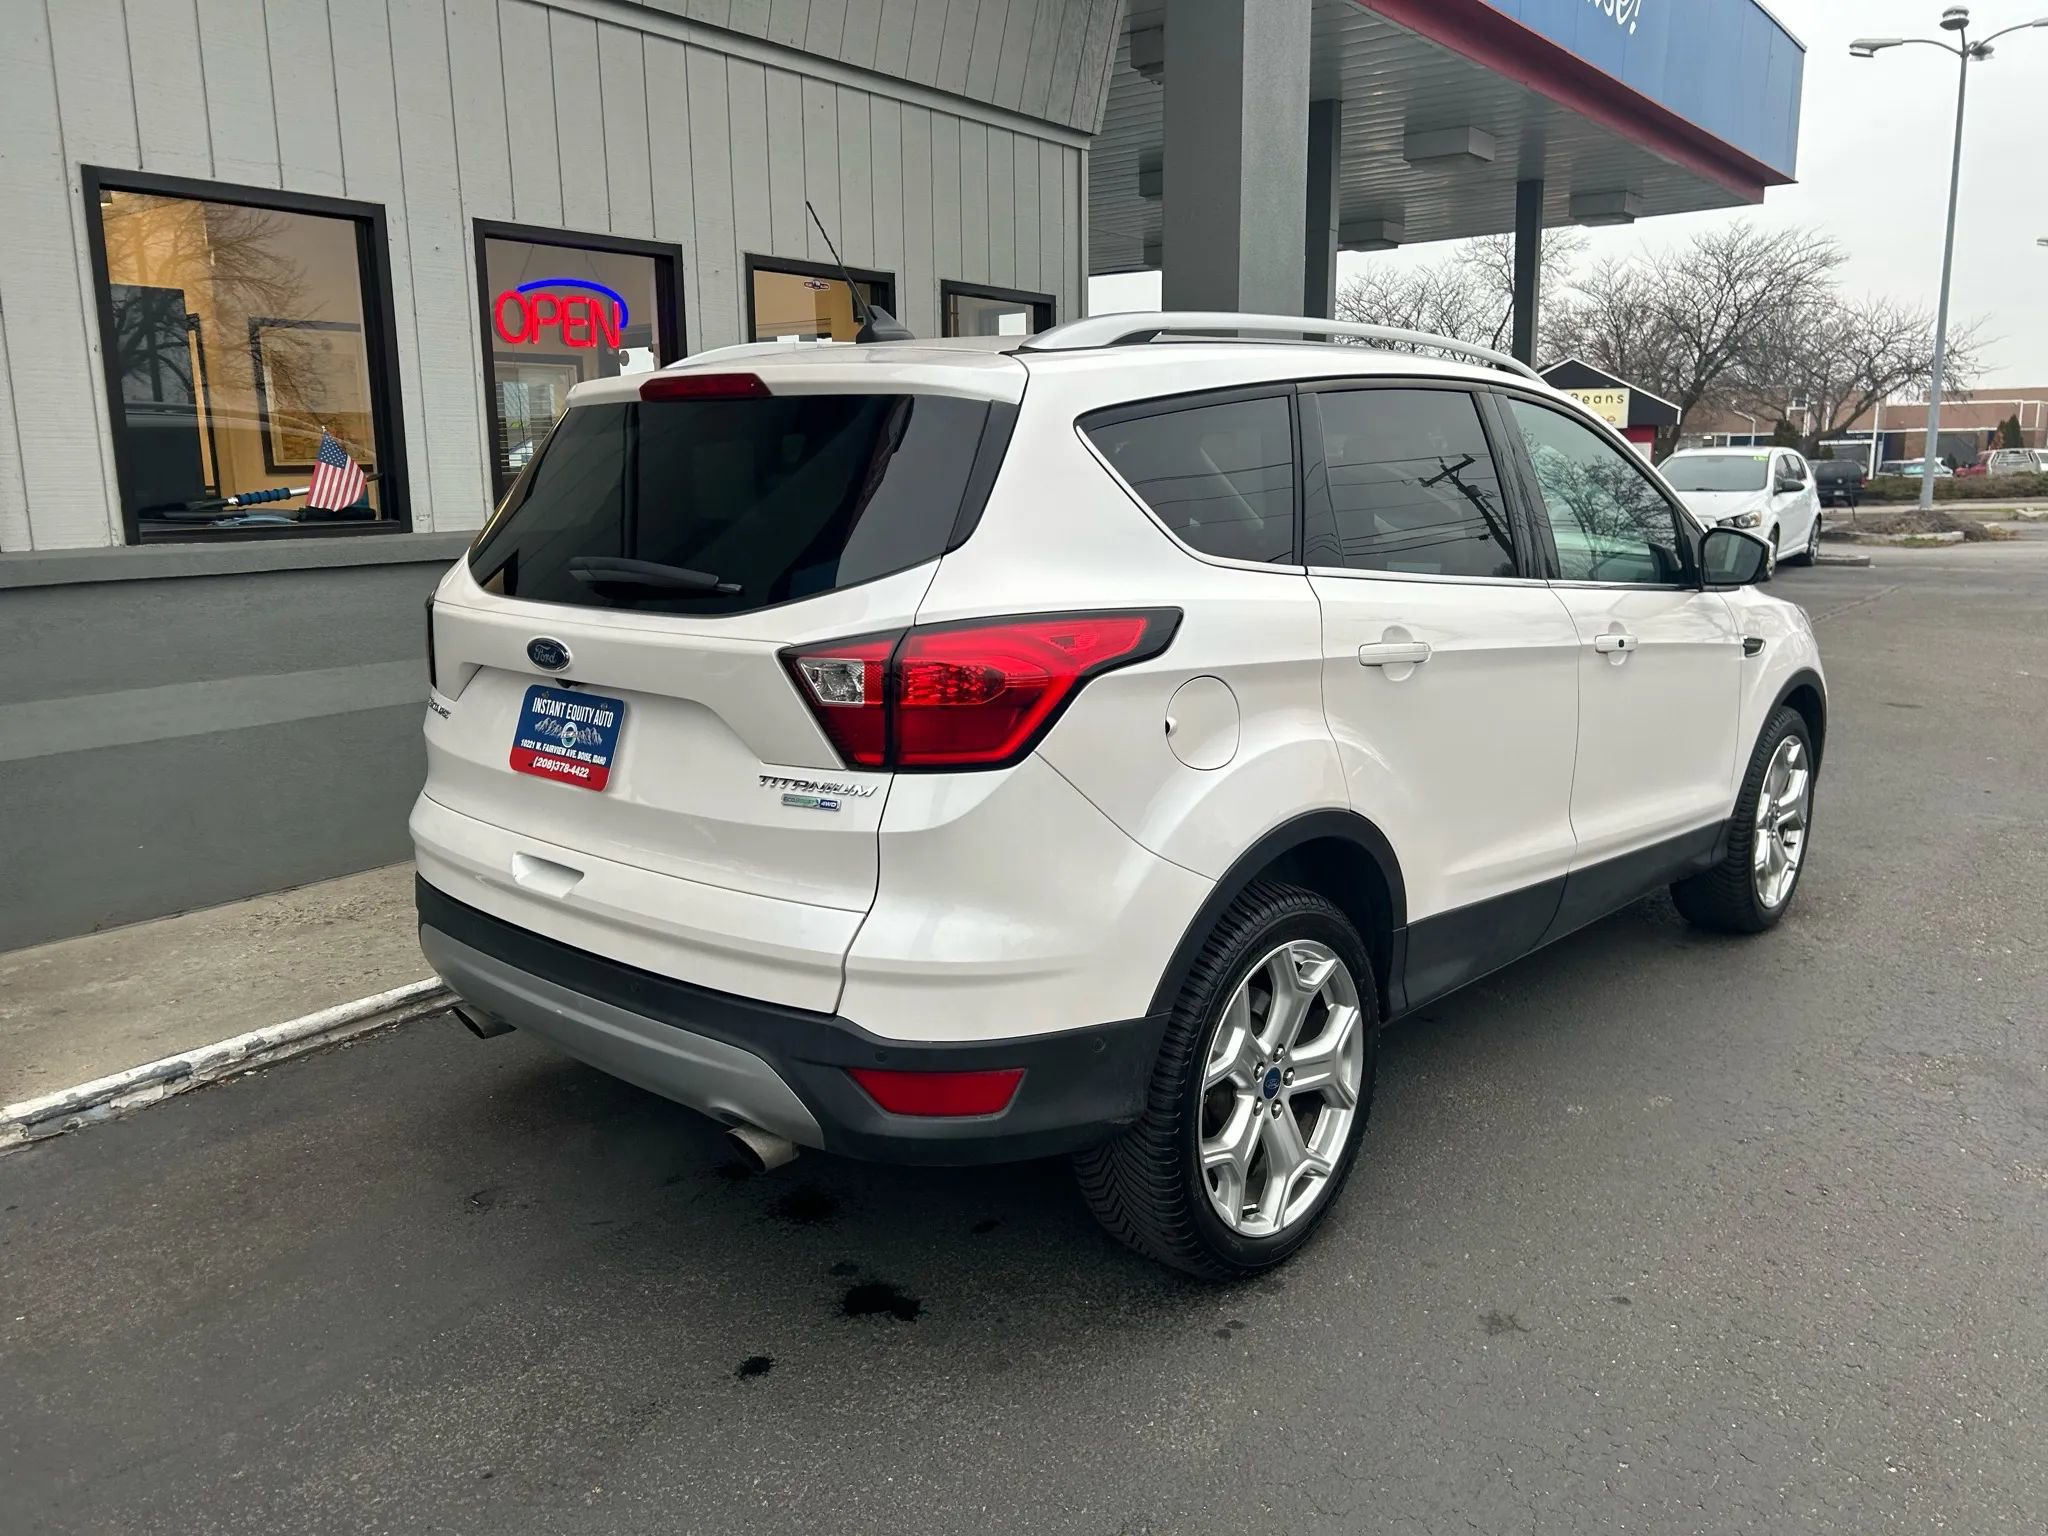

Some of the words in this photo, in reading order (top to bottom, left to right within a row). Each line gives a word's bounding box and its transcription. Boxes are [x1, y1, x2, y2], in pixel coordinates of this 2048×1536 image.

[495, 290, 621, 349] OPEN
[534, 643, 558, 664] Ford
[532, 697, 567, 718] INSTANT
[565, 703, 595, 724] EQUITY
[593, 709, 614, 728] AUTO
[520, 738, 535, 749] 10221
[542, 743, 567, 756] FAIRVIEW
[592, 755, 607, 766] IDAHO
[533, 756, 589, 778] (208)378-4422
[759, 774, 878, 797] TITANIUM
[821, 800, 837, 808] 4WD
